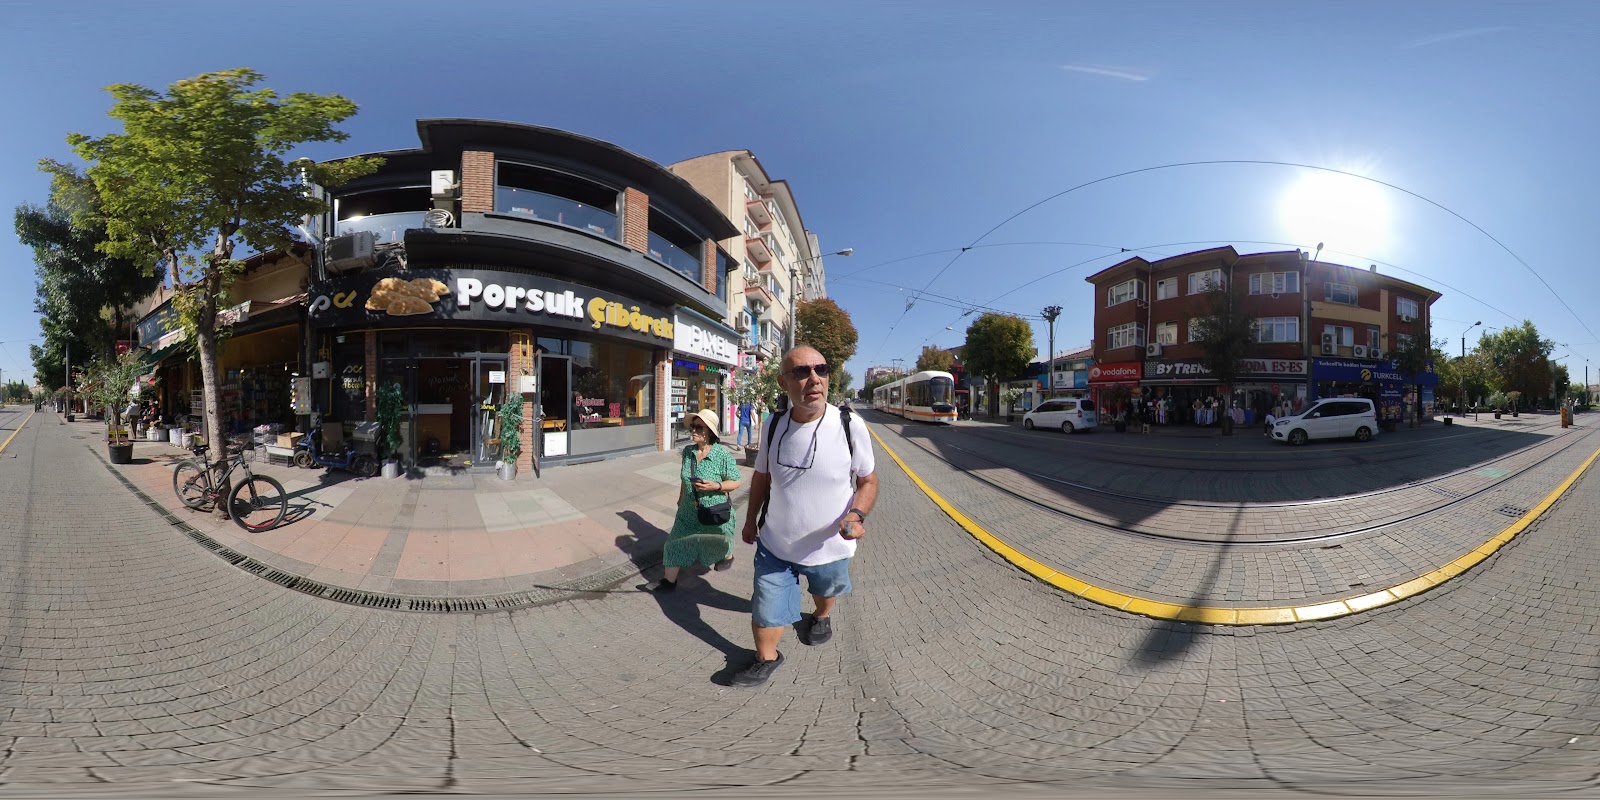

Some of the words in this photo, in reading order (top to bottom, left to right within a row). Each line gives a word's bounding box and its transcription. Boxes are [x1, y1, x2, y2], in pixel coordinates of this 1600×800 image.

[456, 278, 584, 319] Porsuk
[587, 297, 673, 339] Çibörek
[691, 325, 730, 358] PIXEL
[1102, 367, 1137, 376] vodafone
[1156, 363, 1173, 375] BY
[1272, 361, 1303, 373] ES-ES
[1373, 371, 1403, 381] TURKCELL
[609, 403, 620, 418] 35
